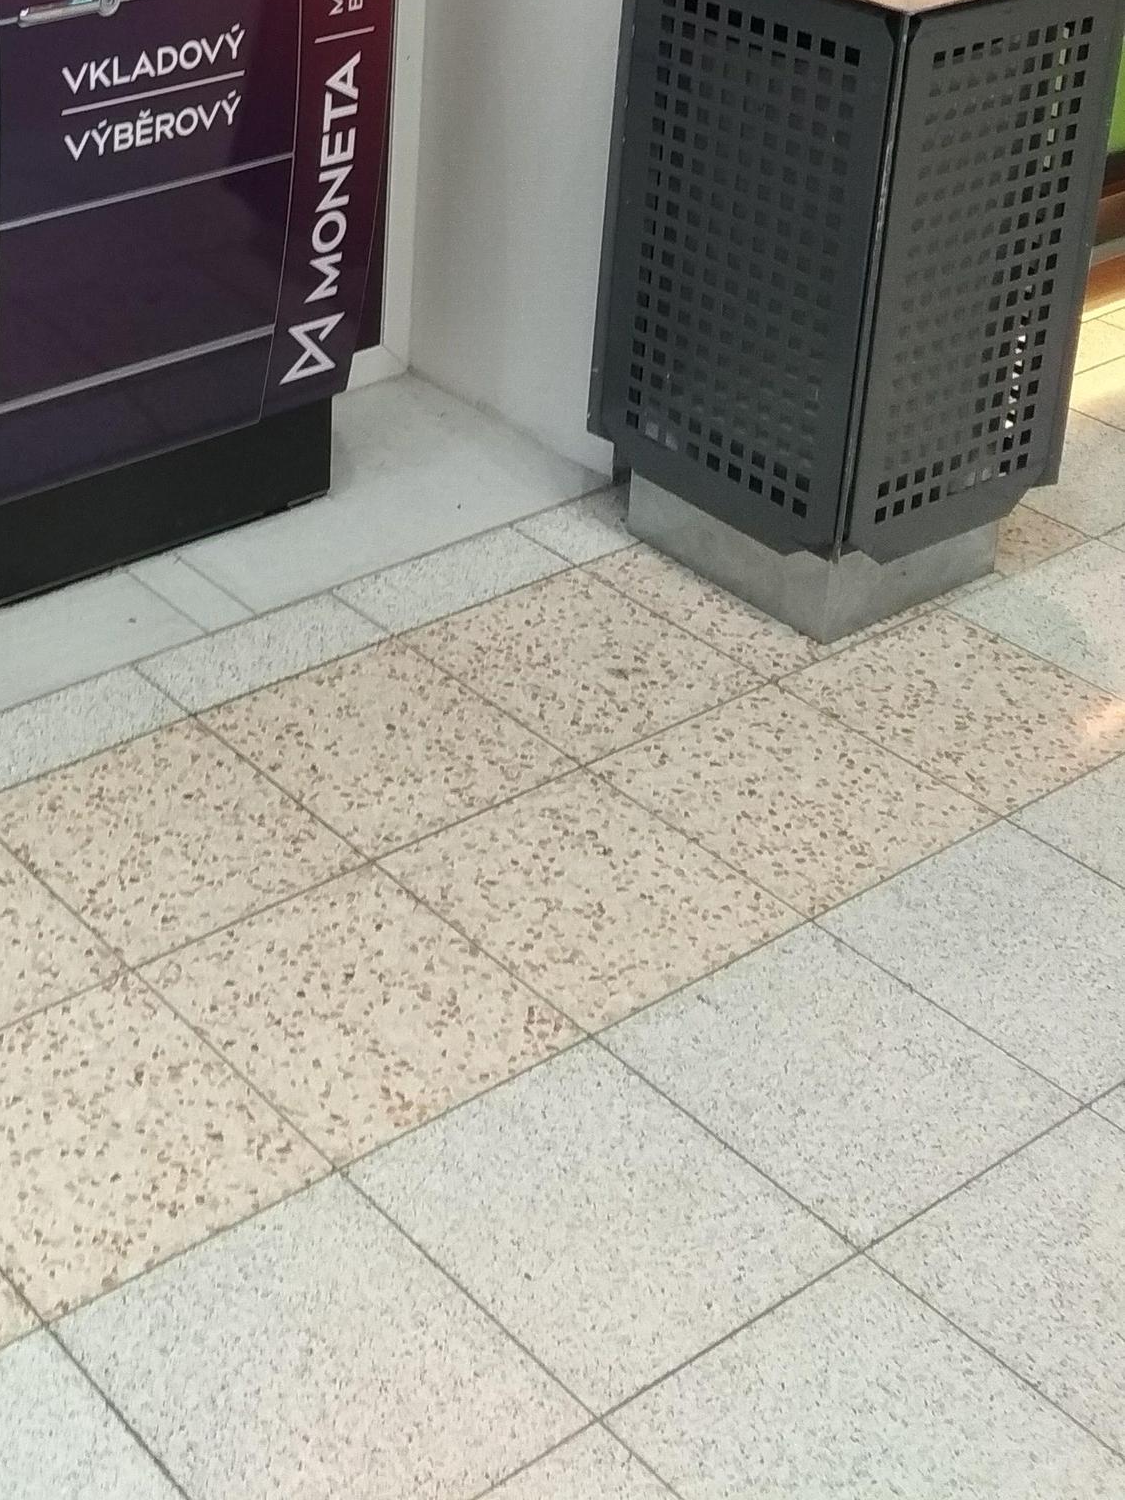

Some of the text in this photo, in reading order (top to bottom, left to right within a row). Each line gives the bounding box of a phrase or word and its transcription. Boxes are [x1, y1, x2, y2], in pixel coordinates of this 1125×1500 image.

[61, 23, 246, 95] VKLADOVÝ
[63, 89, 243, 162] VÝBĚROVÝ
[304, 50, 362, 305] MONETA
